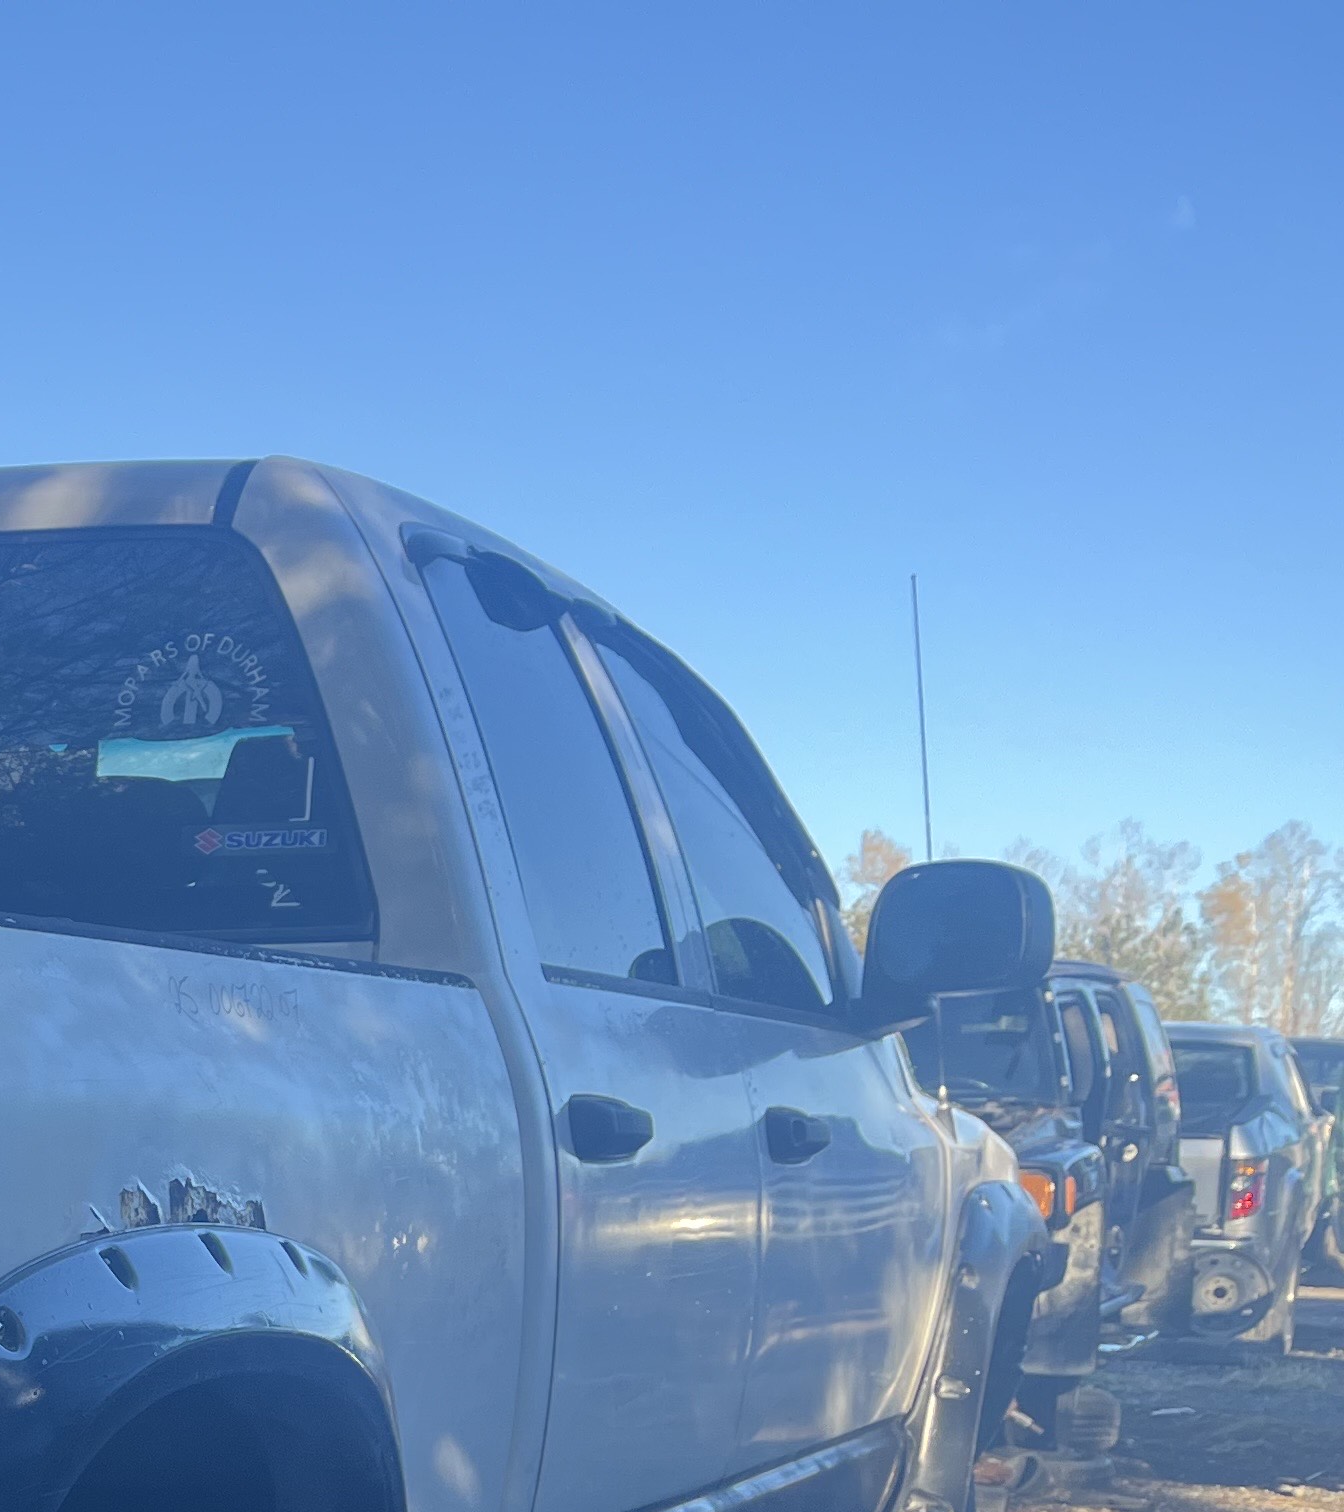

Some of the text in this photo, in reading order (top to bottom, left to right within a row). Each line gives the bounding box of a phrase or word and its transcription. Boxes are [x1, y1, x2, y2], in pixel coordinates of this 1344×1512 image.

[114, 633, 271, 727] MOPARS OF DURHAM
[224, 829, 327, 849] SUZUKI
